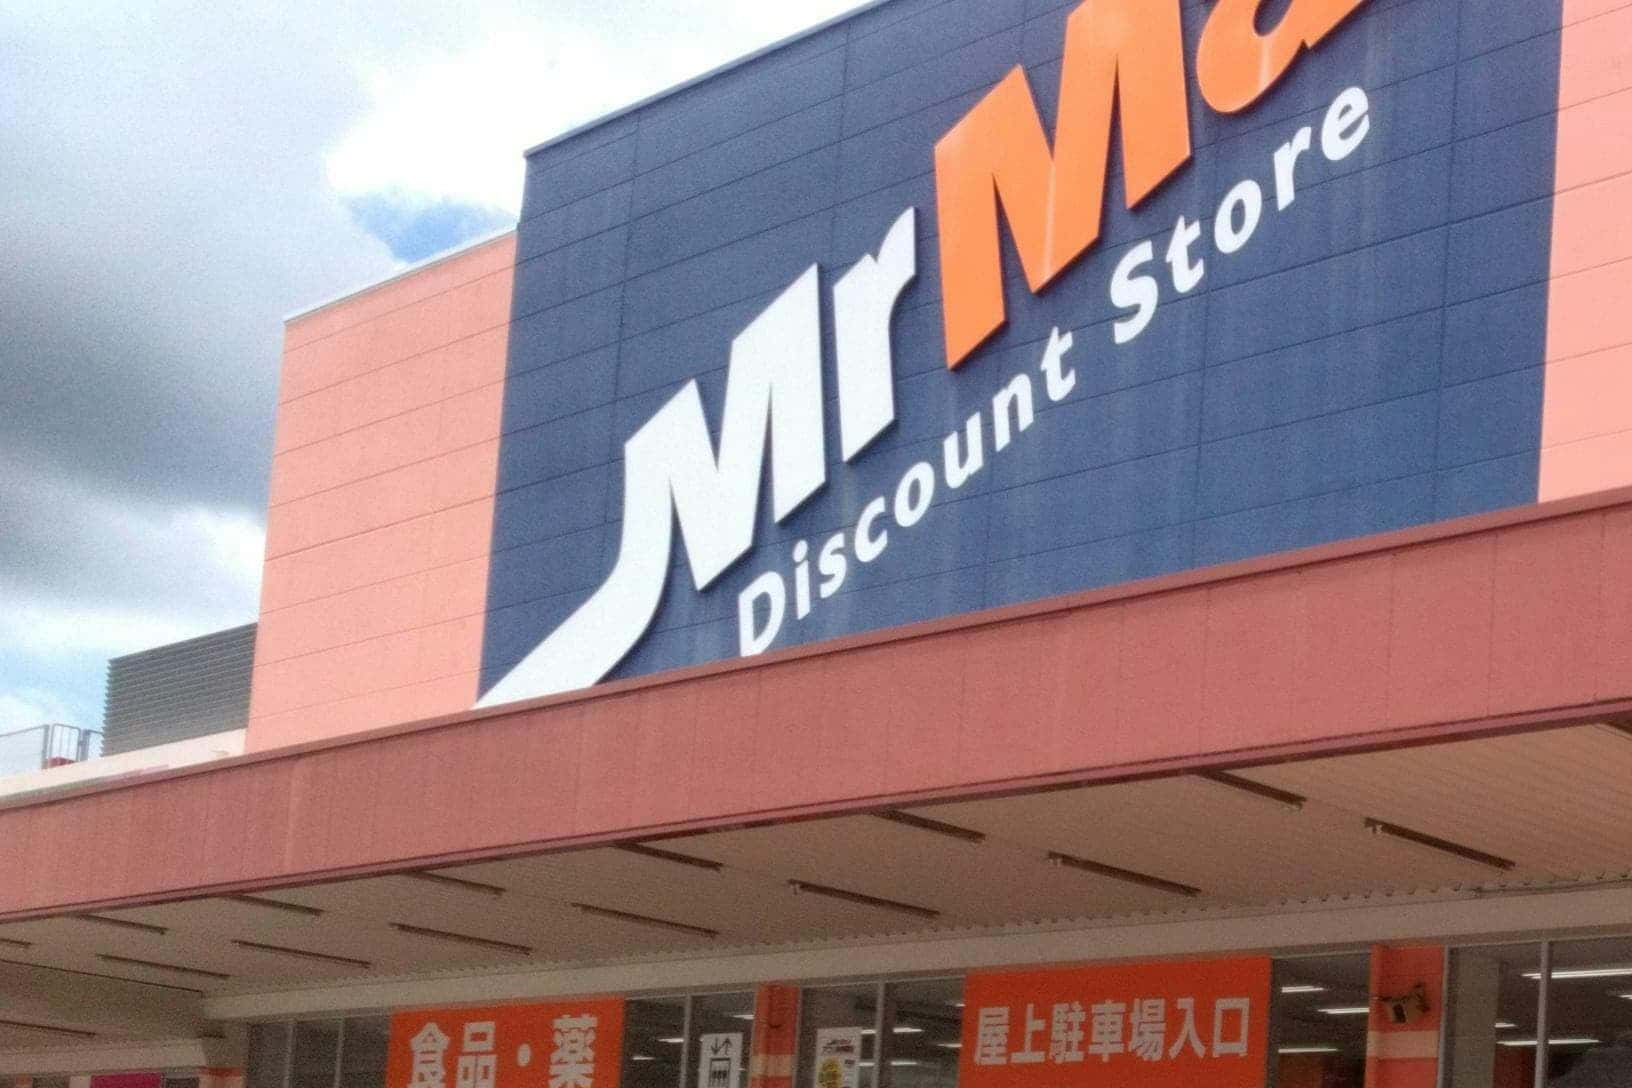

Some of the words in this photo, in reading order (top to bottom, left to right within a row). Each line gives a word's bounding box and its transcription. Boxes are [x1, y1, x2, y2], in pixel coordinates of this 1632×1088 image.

[738, 326, 1075, 656] Discount
[1110, 86, 1370, 344] Store
[974, 997, 1251, 1066] 屋上駐車場入口
